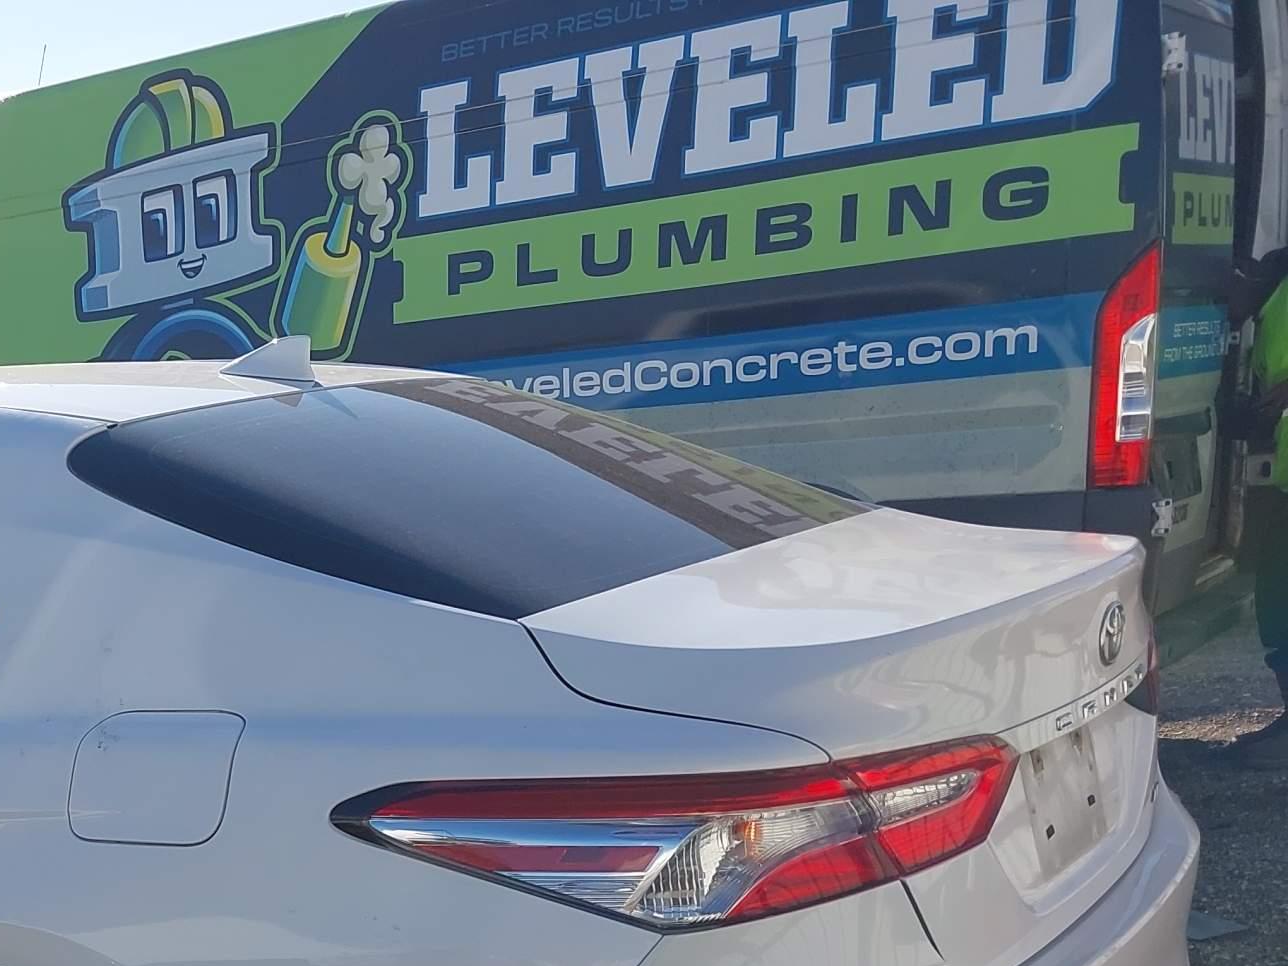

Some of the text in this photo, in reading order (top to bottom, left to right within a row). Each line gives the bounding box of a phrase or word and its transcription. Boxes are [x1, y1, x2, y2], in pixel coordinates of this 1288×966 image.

[440, 22, 549, 63] BETTER
[418, 0, 1117, 218] LEVELED
[1178, 54, 1236, 165] LEV
[446, 165, 1051, 296] PLUMBING
